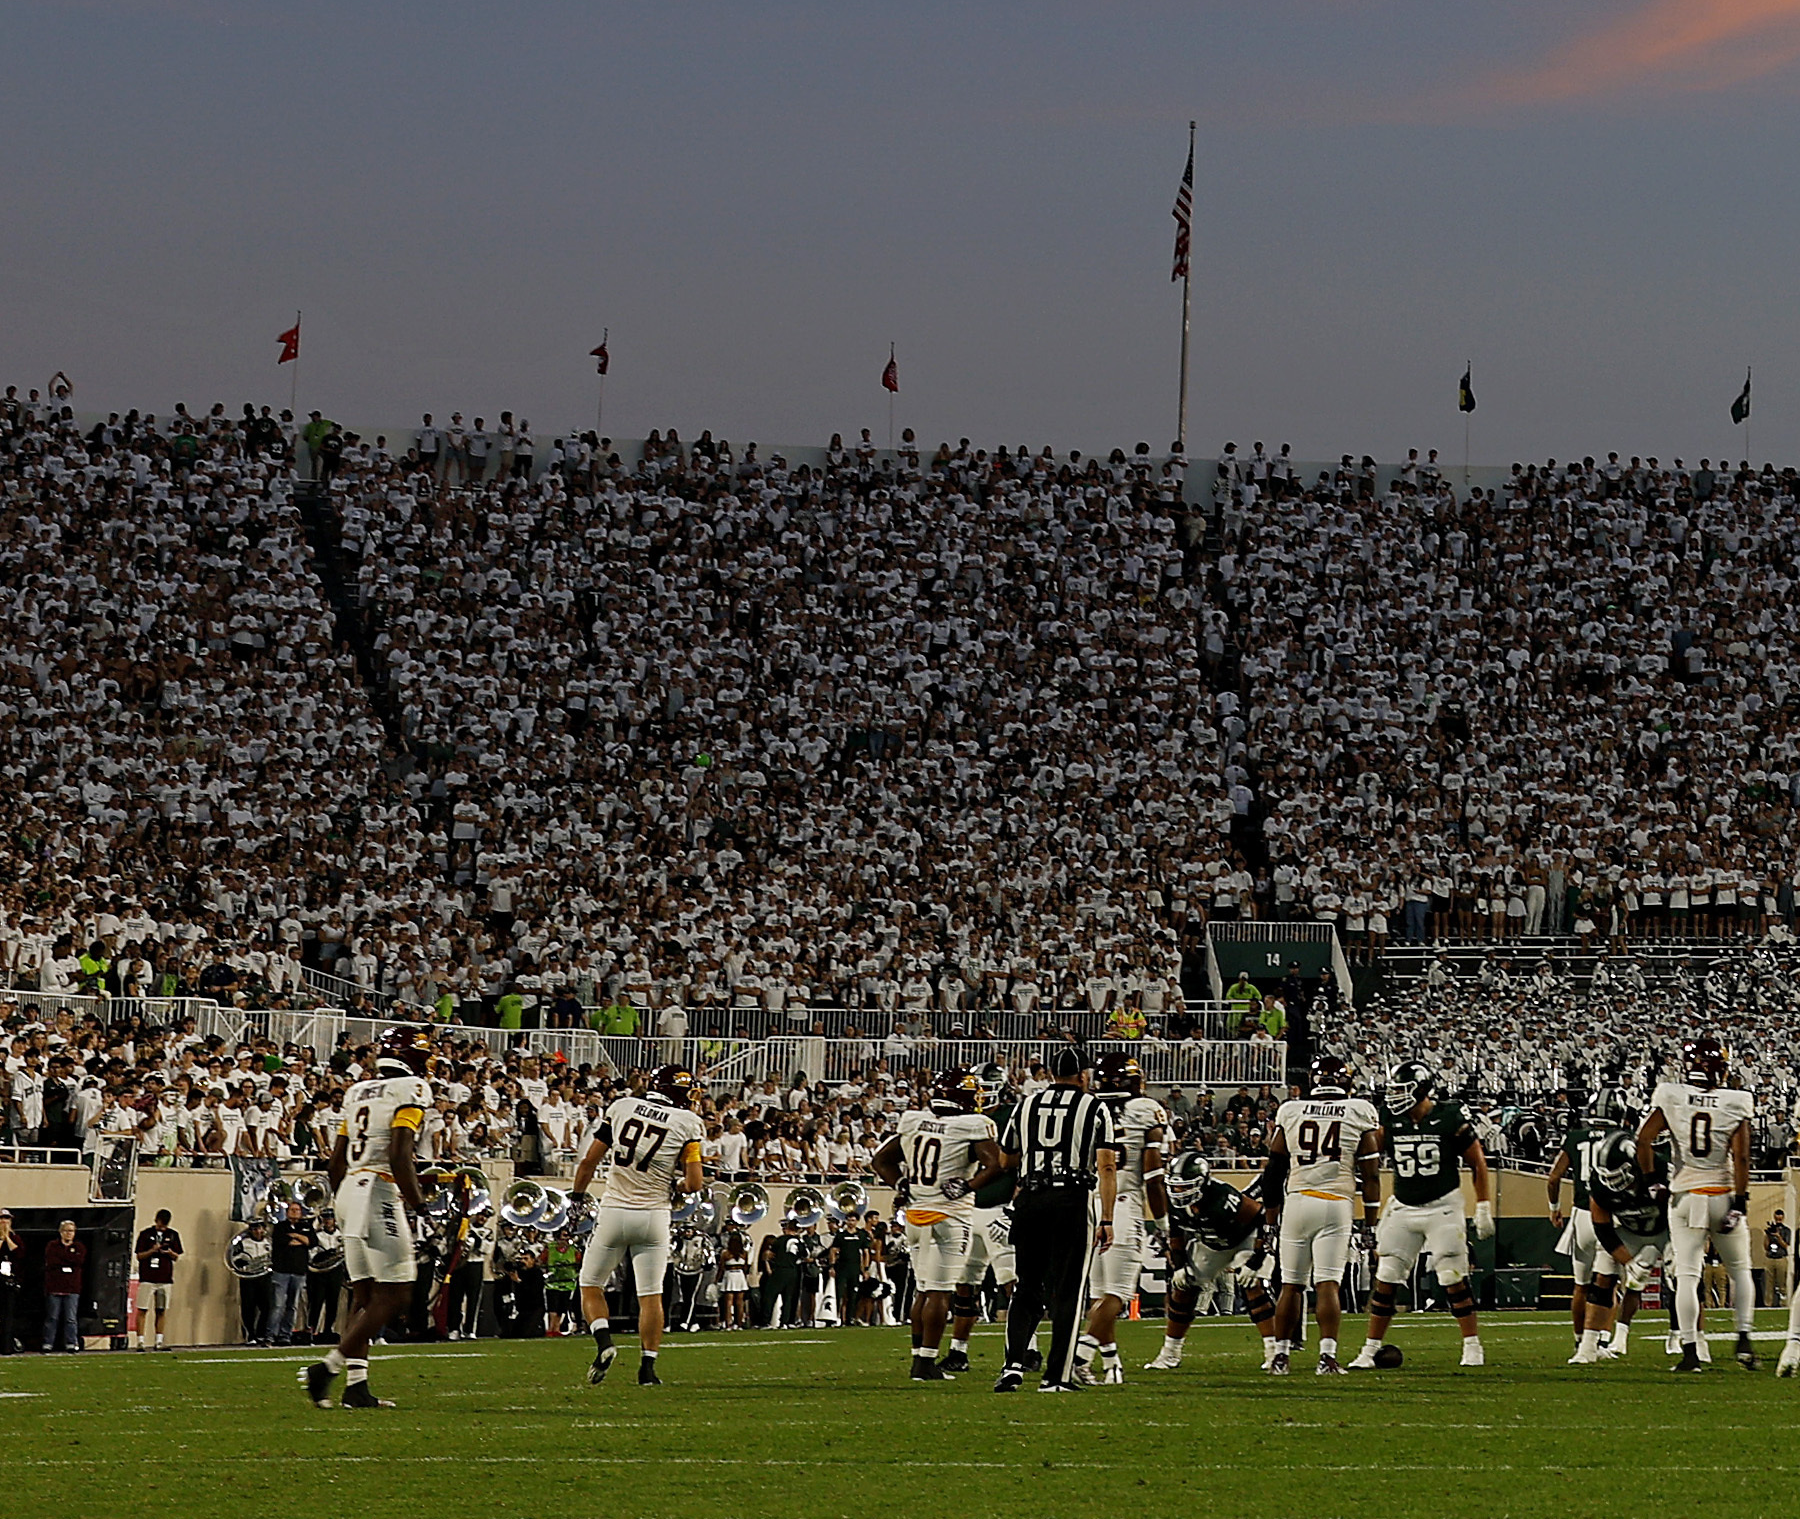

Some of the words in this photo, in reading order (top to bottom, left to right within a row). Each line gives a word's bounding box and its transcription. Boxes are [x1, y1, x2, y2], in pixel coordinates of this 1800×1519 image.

[1266, 953, 1280, 967] 14
[1037, 1107, 1068, 1147] U
[1302, 1104, 1346, 1118] J.WILLIAMS
[352, 1105, 369, 1162] 3
[614, 1118, 668, 1173] 97
[1297, 1120, 1342, 1166] 94
[1689, 1112, 1712, 1158] 0
[908, 1134, 942, 1186] 10
[1394, 1143, 1441, 1178] 59
[1224, 1193, 1241, 1213] 74
